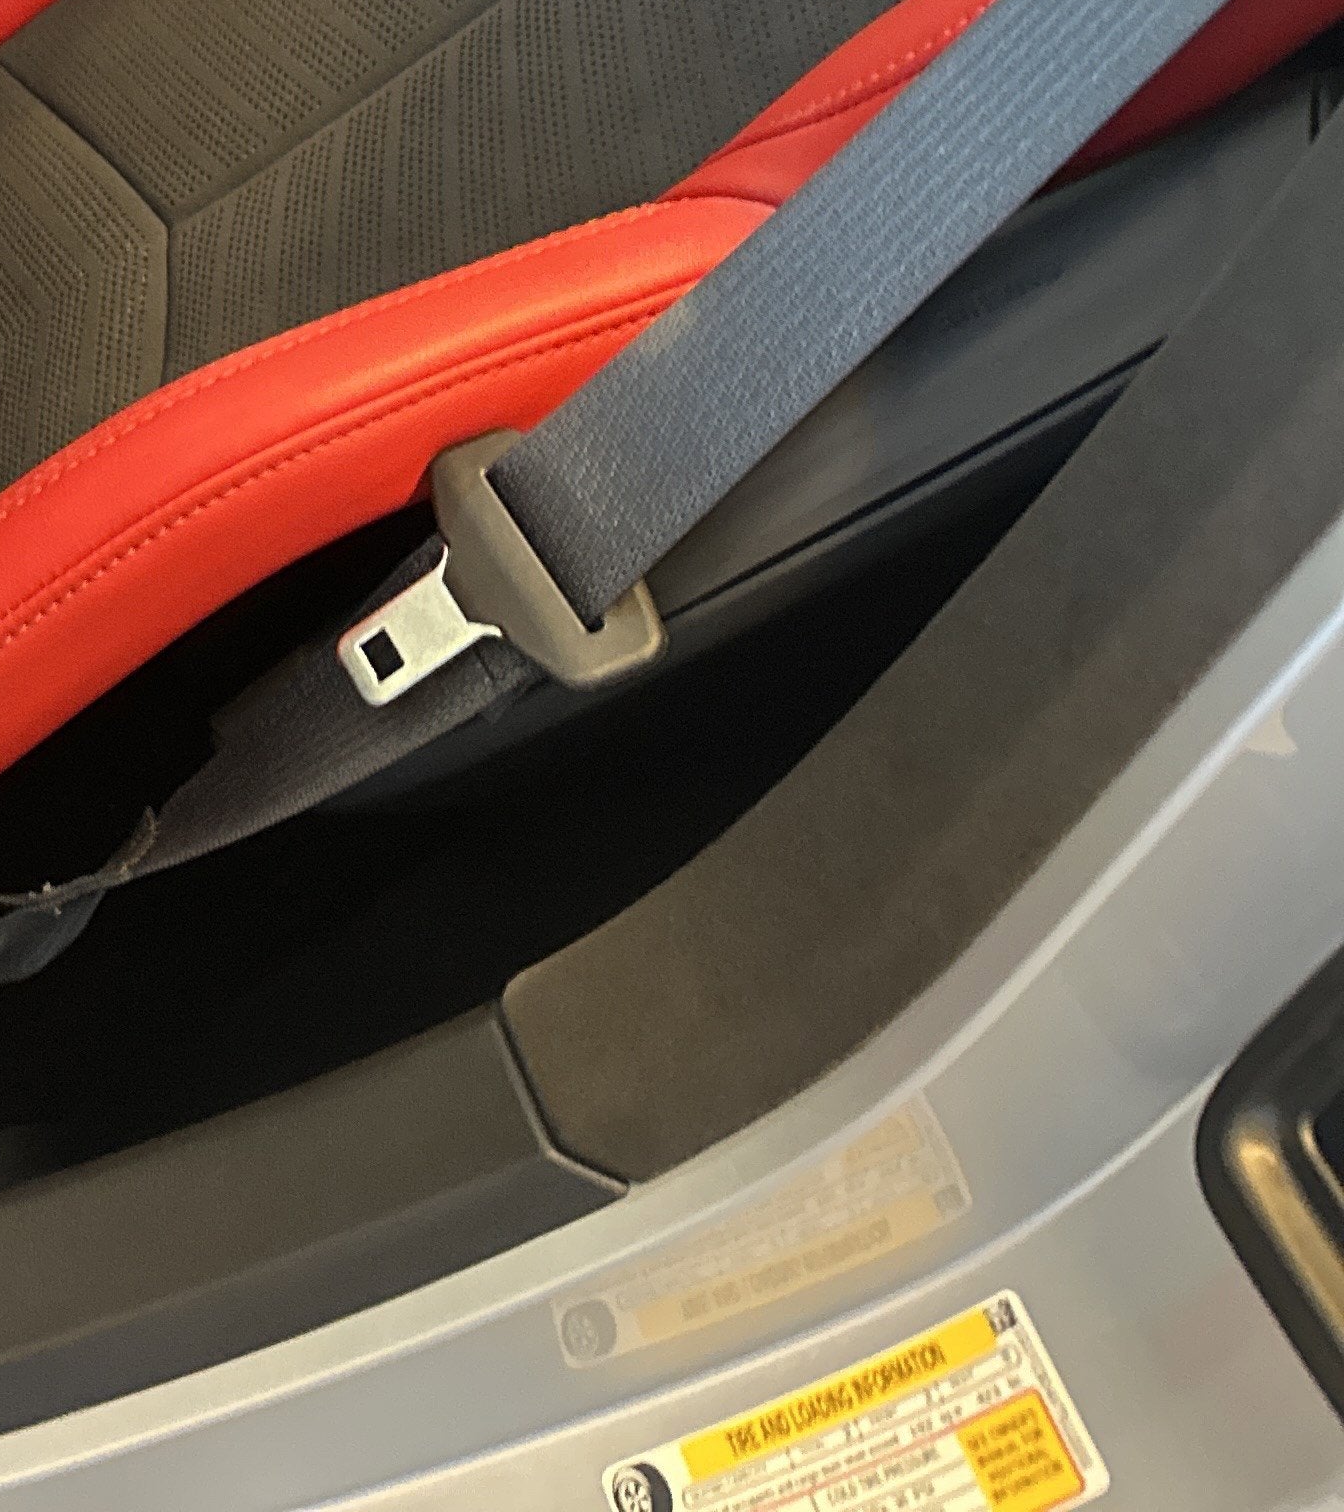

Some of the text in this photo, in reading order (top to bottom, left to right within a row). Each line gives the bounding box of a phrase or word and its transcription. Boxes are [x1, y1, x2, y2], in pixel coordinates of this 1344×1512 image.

[725, 1420, 761, 1458] TIRE
[759, 1408, 791, 1443] AND
[788, 1381, 854, 1433] LOADING
[850, 1338, 948, 1405] INFORMATION
